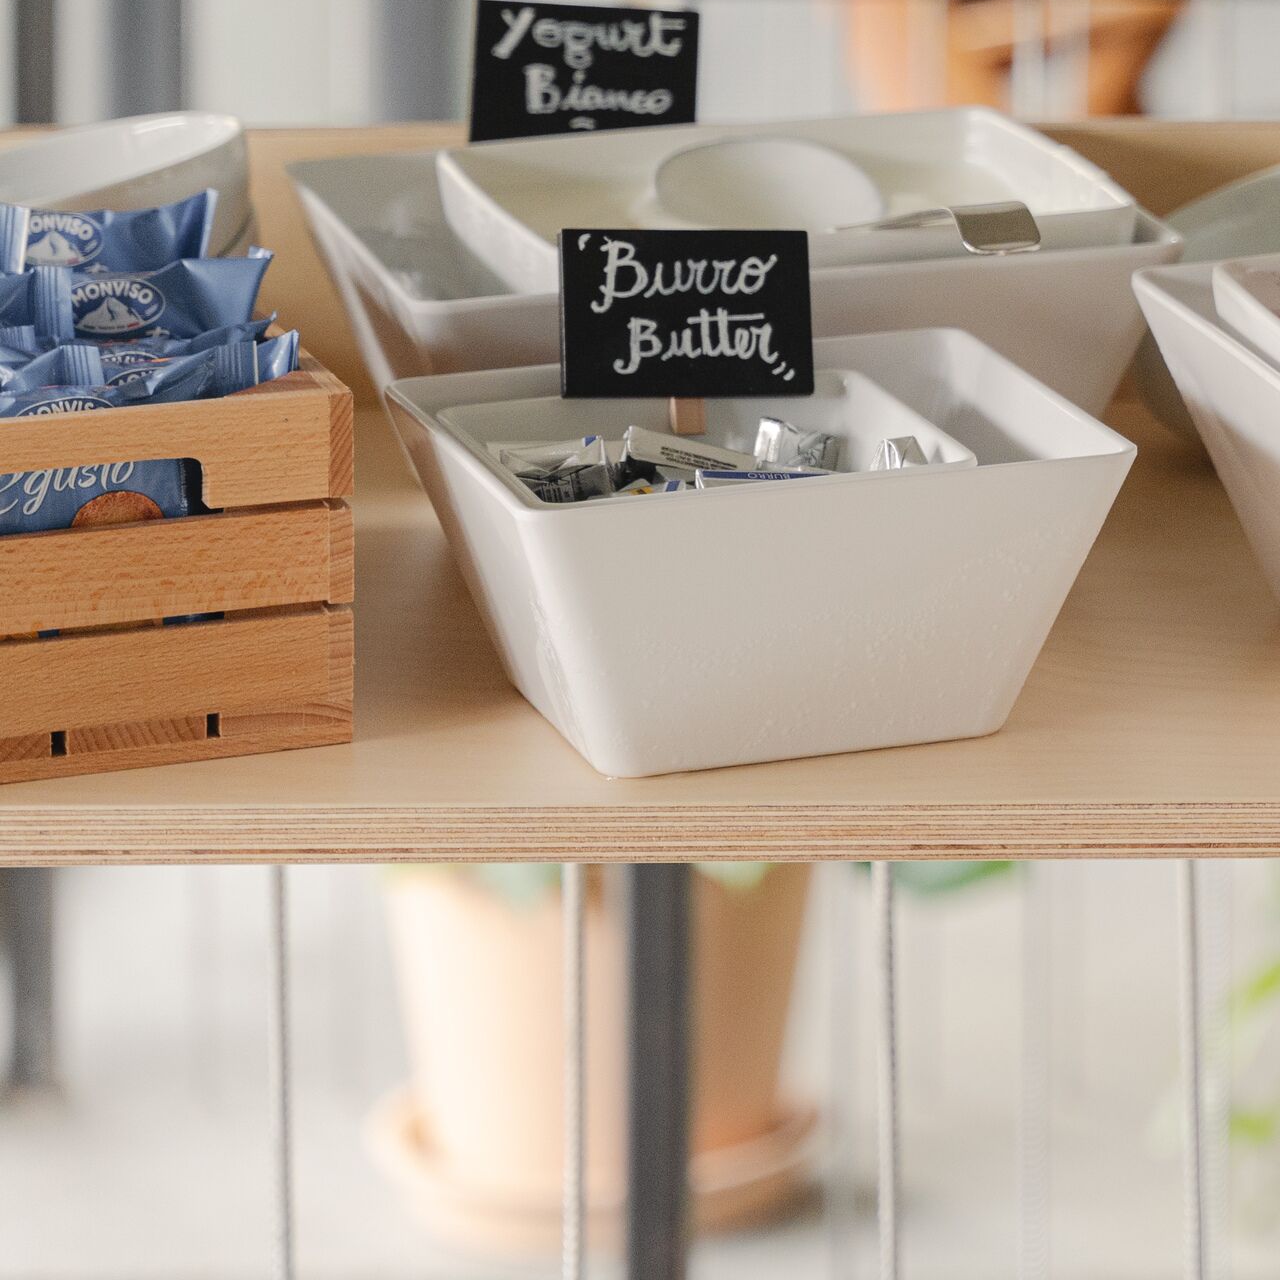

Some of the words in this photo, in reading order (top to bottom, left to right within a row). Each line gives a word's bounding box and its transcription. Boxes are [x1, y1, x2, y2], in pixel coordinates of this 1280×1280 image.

[491, 7, 687, 69] Yogurt
[523, 62, 674, 115] Bianco
[29, 214, 94, 240] ONVISO
[72, 281, 153, 308] MONVISO
[590, 236, 778, 314] Burro
